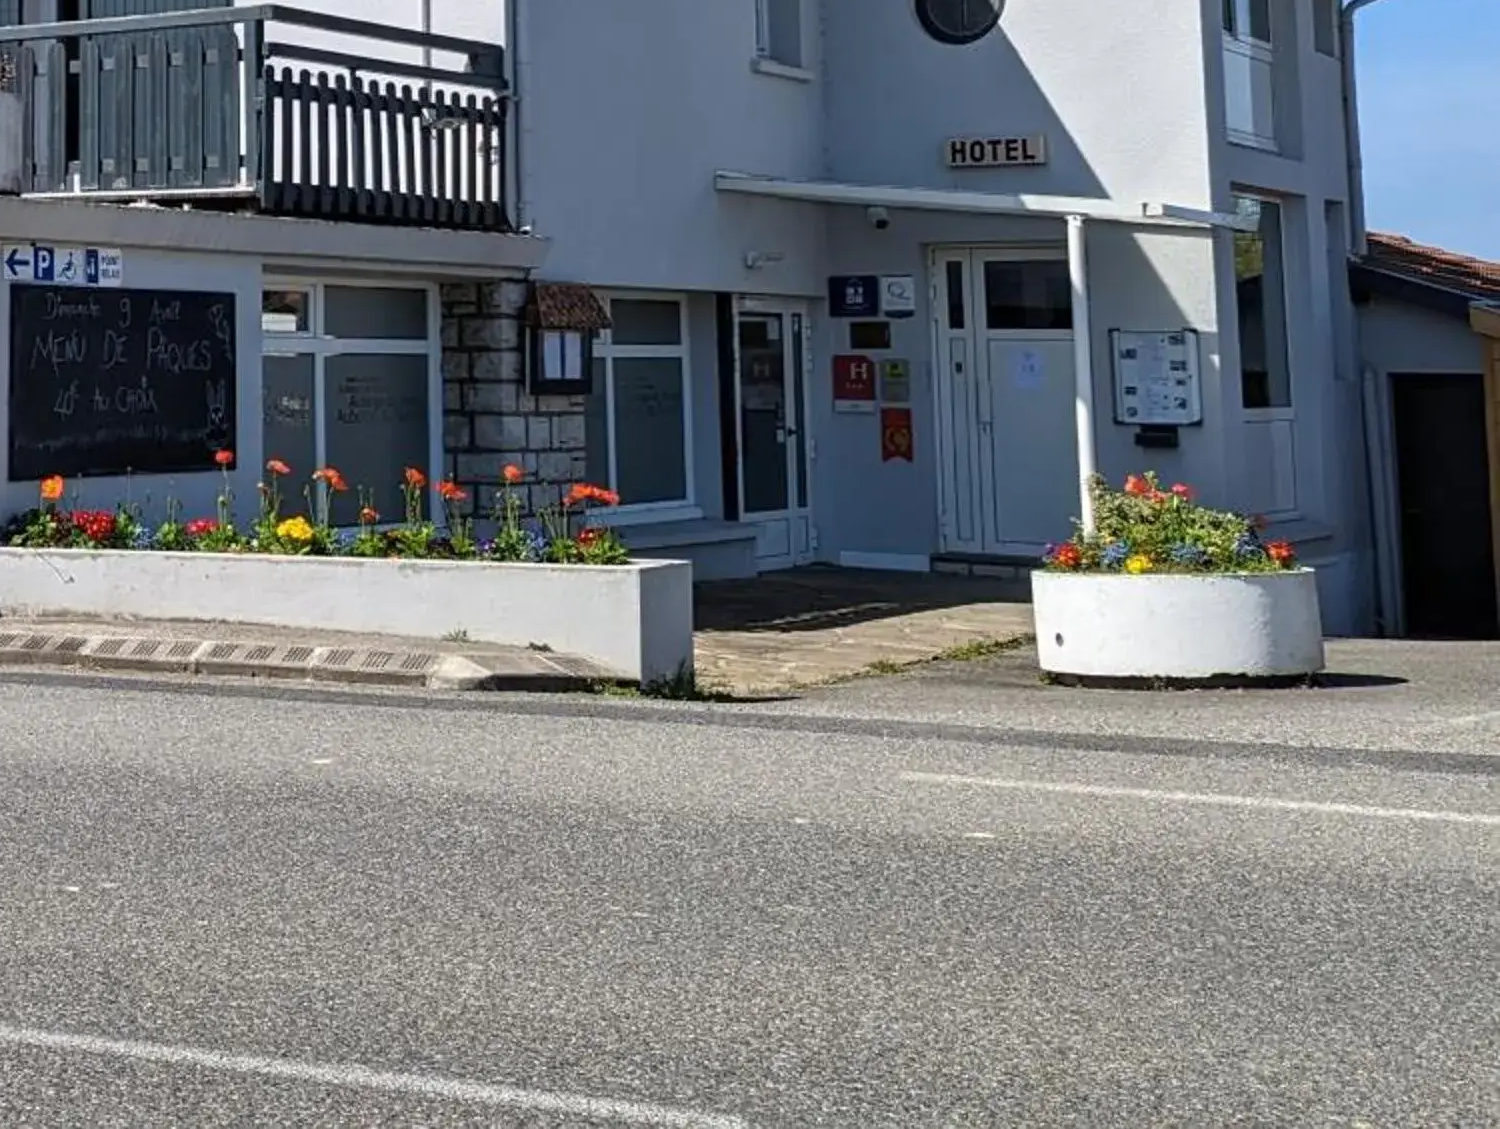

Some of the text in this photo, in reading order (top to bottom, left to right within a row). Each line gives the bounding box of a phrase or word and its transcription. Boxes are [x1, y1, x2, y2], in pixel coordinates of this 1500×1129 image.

[949, 138, 1036, 163] HOTEL
[30, 328, 88, 377] MENU
[100, 328, 129, 369] DE
